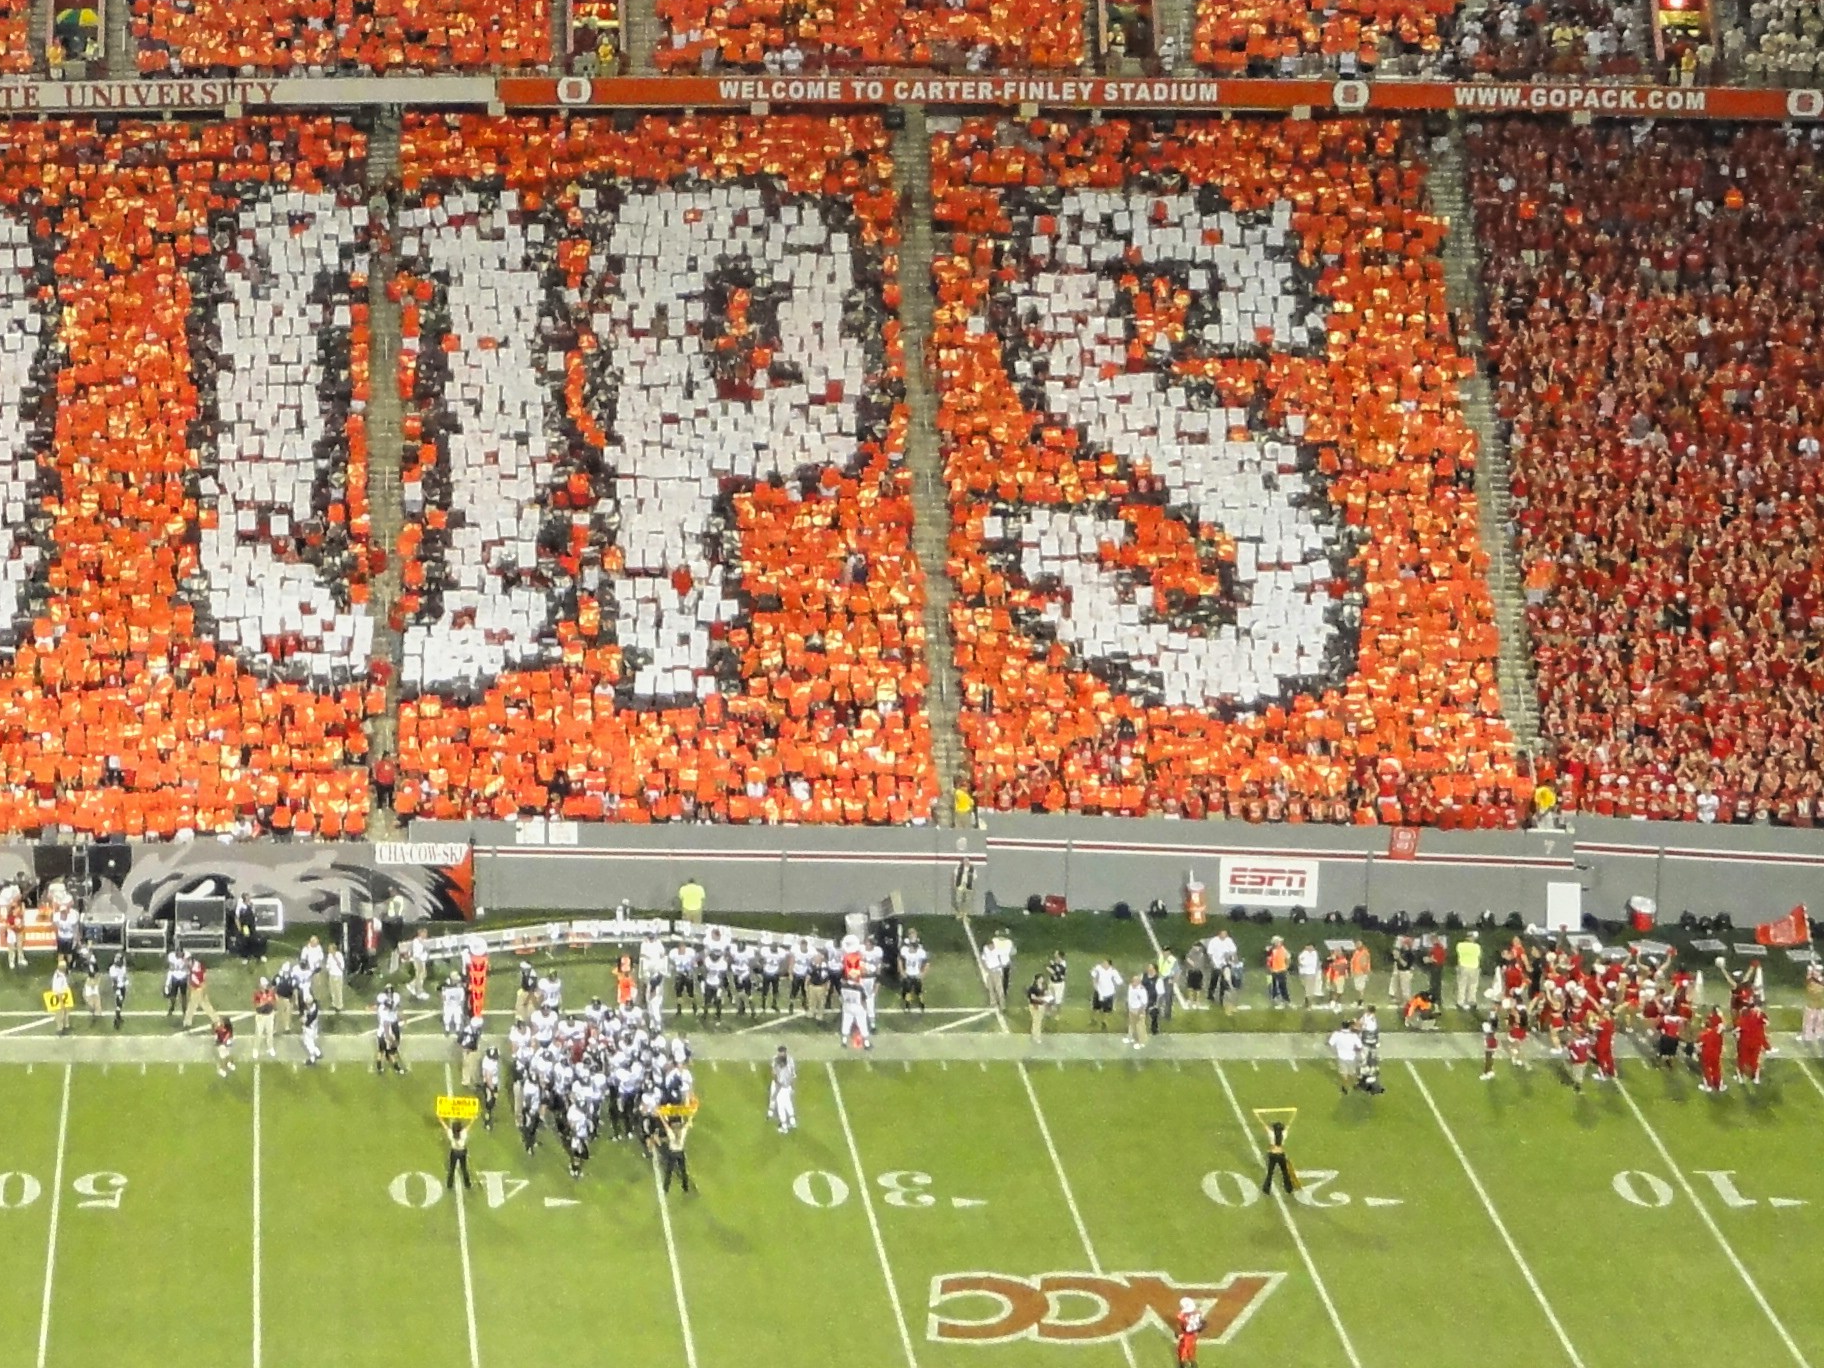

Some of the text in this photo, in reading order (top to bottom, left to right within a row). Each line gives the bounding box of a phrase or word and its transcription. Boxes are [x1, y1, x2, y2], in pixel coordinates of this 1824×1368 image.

[65, 82, 278, 107] UNIVERSITY
[719, 81, 1217, 102] WELCOME TO CARTER-FINLEY STADIUM
[1454, 87, 1705, 111] WWW.GOPACK.COM
[1229, 867, 1307, 888] ESPN
[926, 1271, 1288, 1344] ACC
